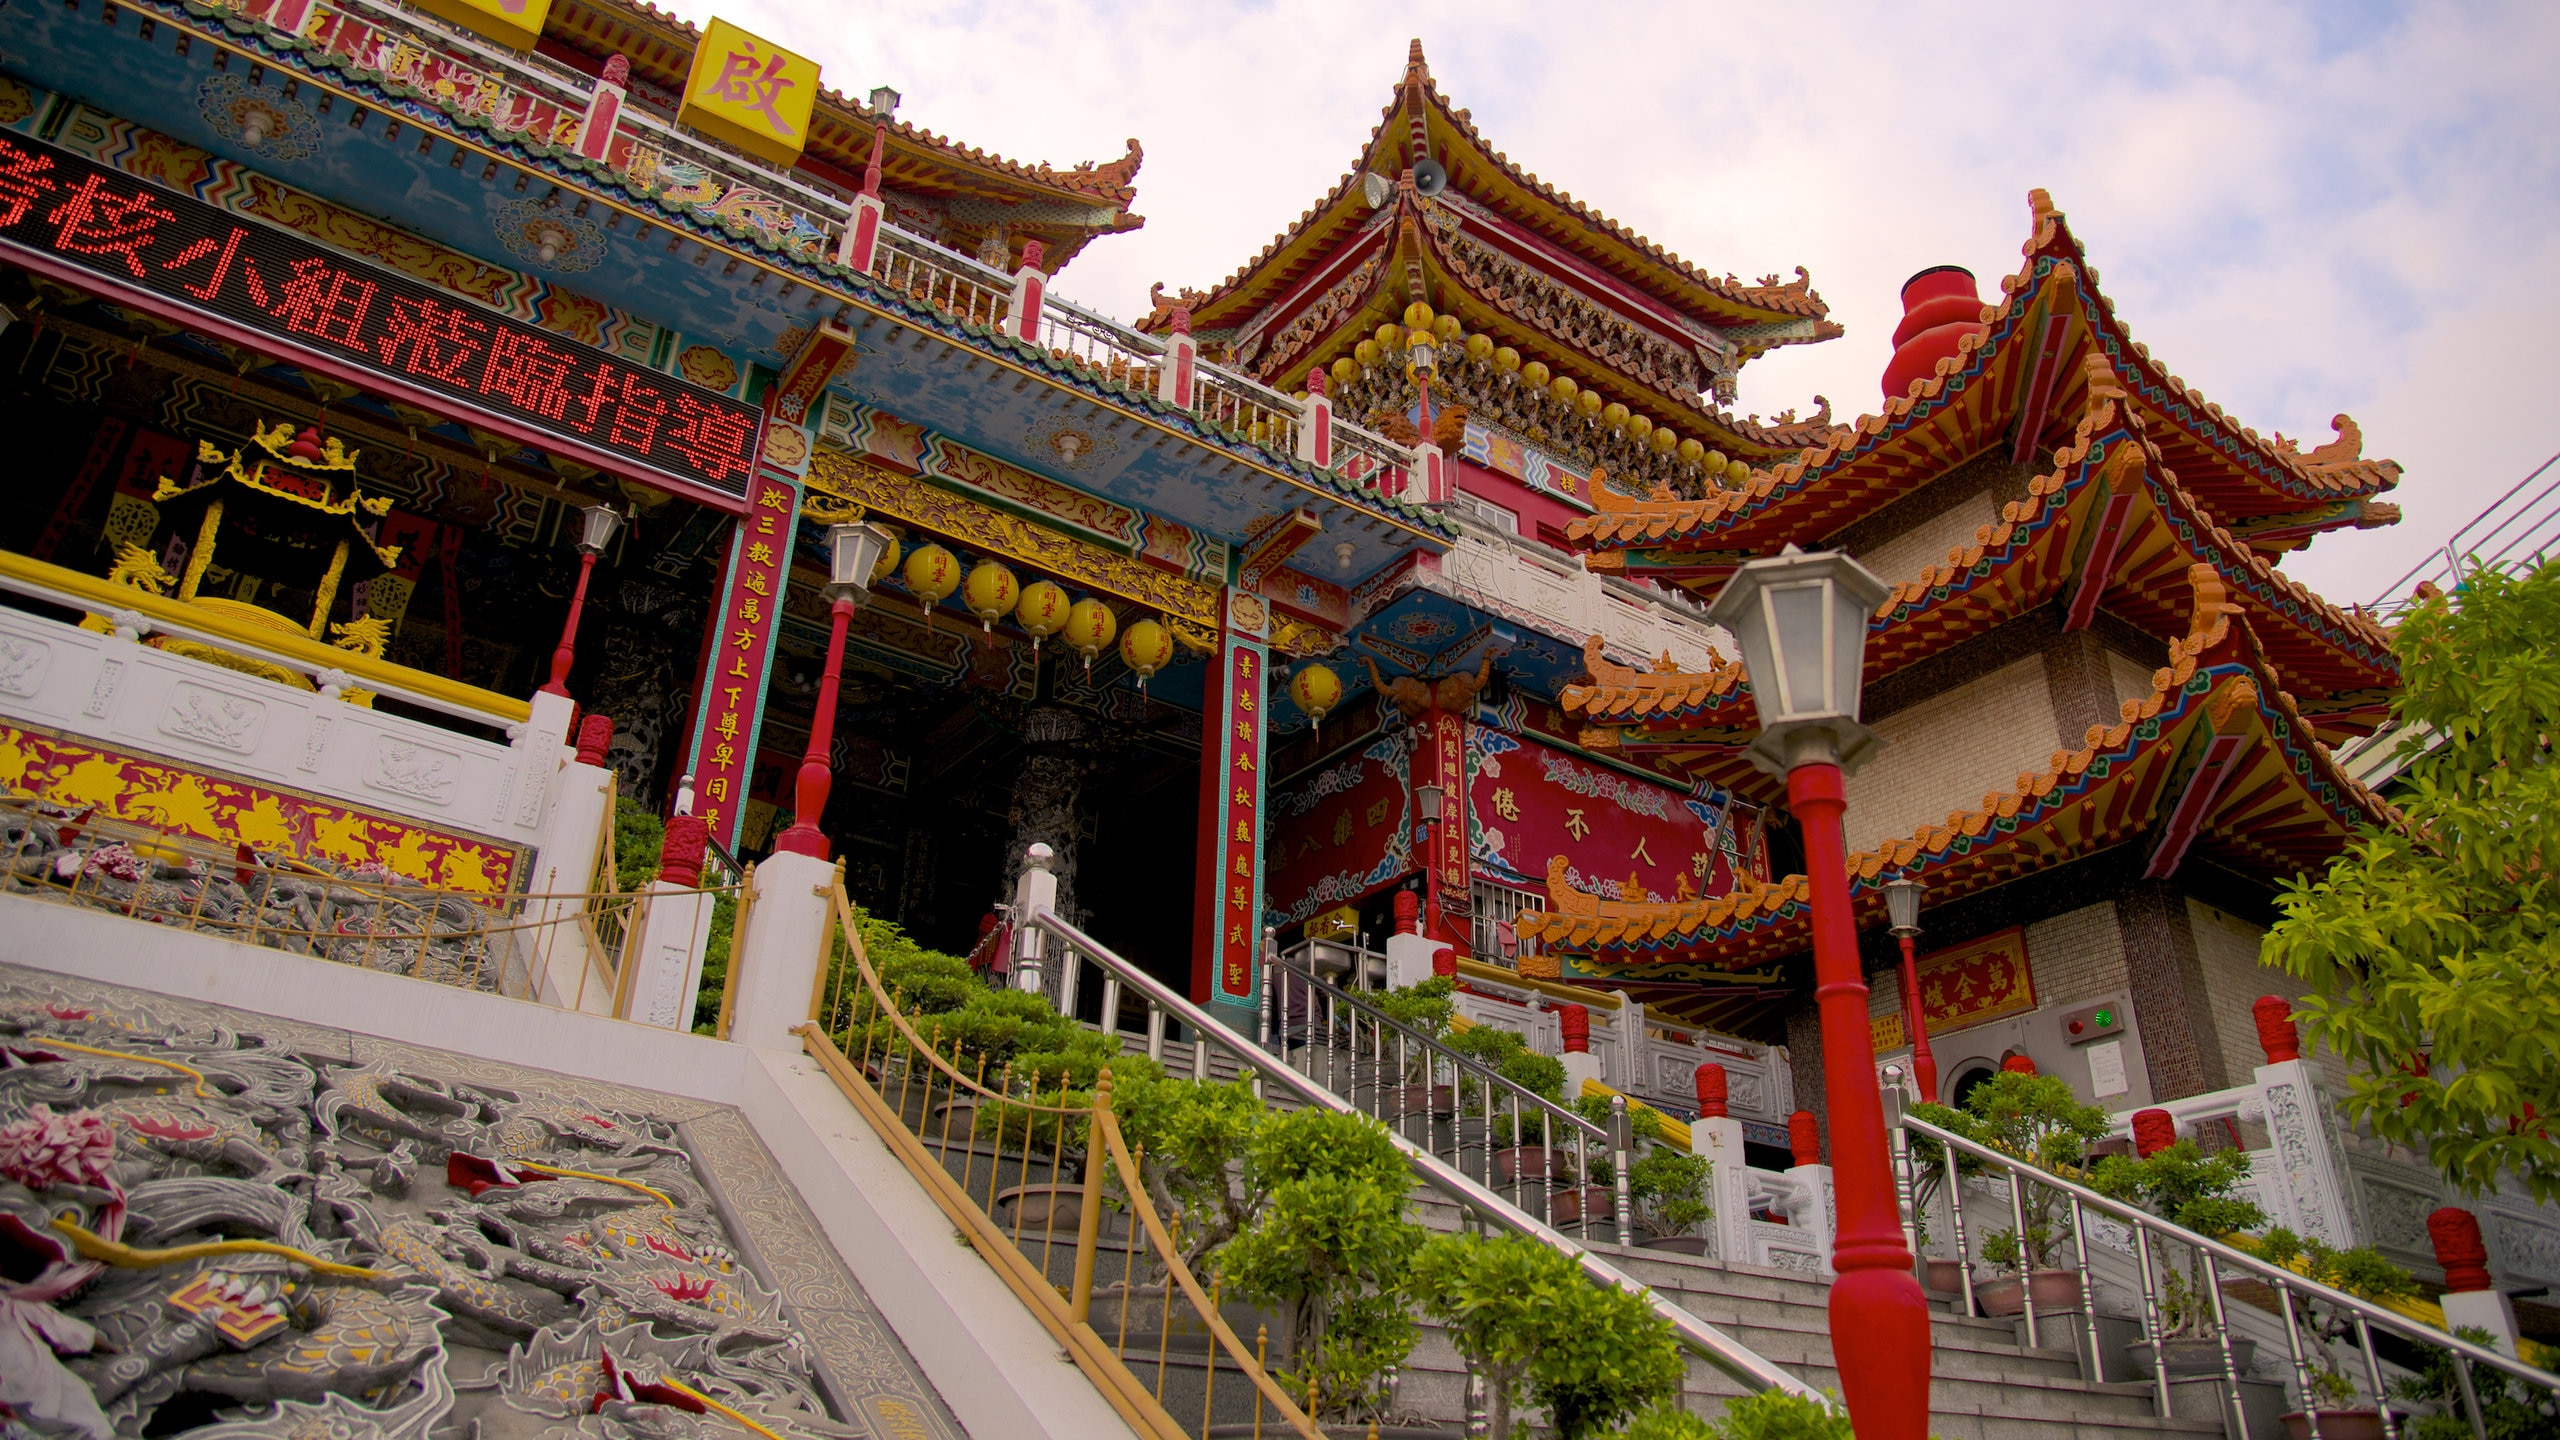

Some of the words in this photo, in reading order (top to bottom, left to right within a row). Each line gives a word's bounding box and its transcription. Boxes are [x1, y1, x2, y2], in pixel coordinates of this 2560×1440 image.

[697, 485, 788, 861] 啟三教遍萬方上下尊卑同景
[1924, 960, 2008, 1009] 萬金爐
